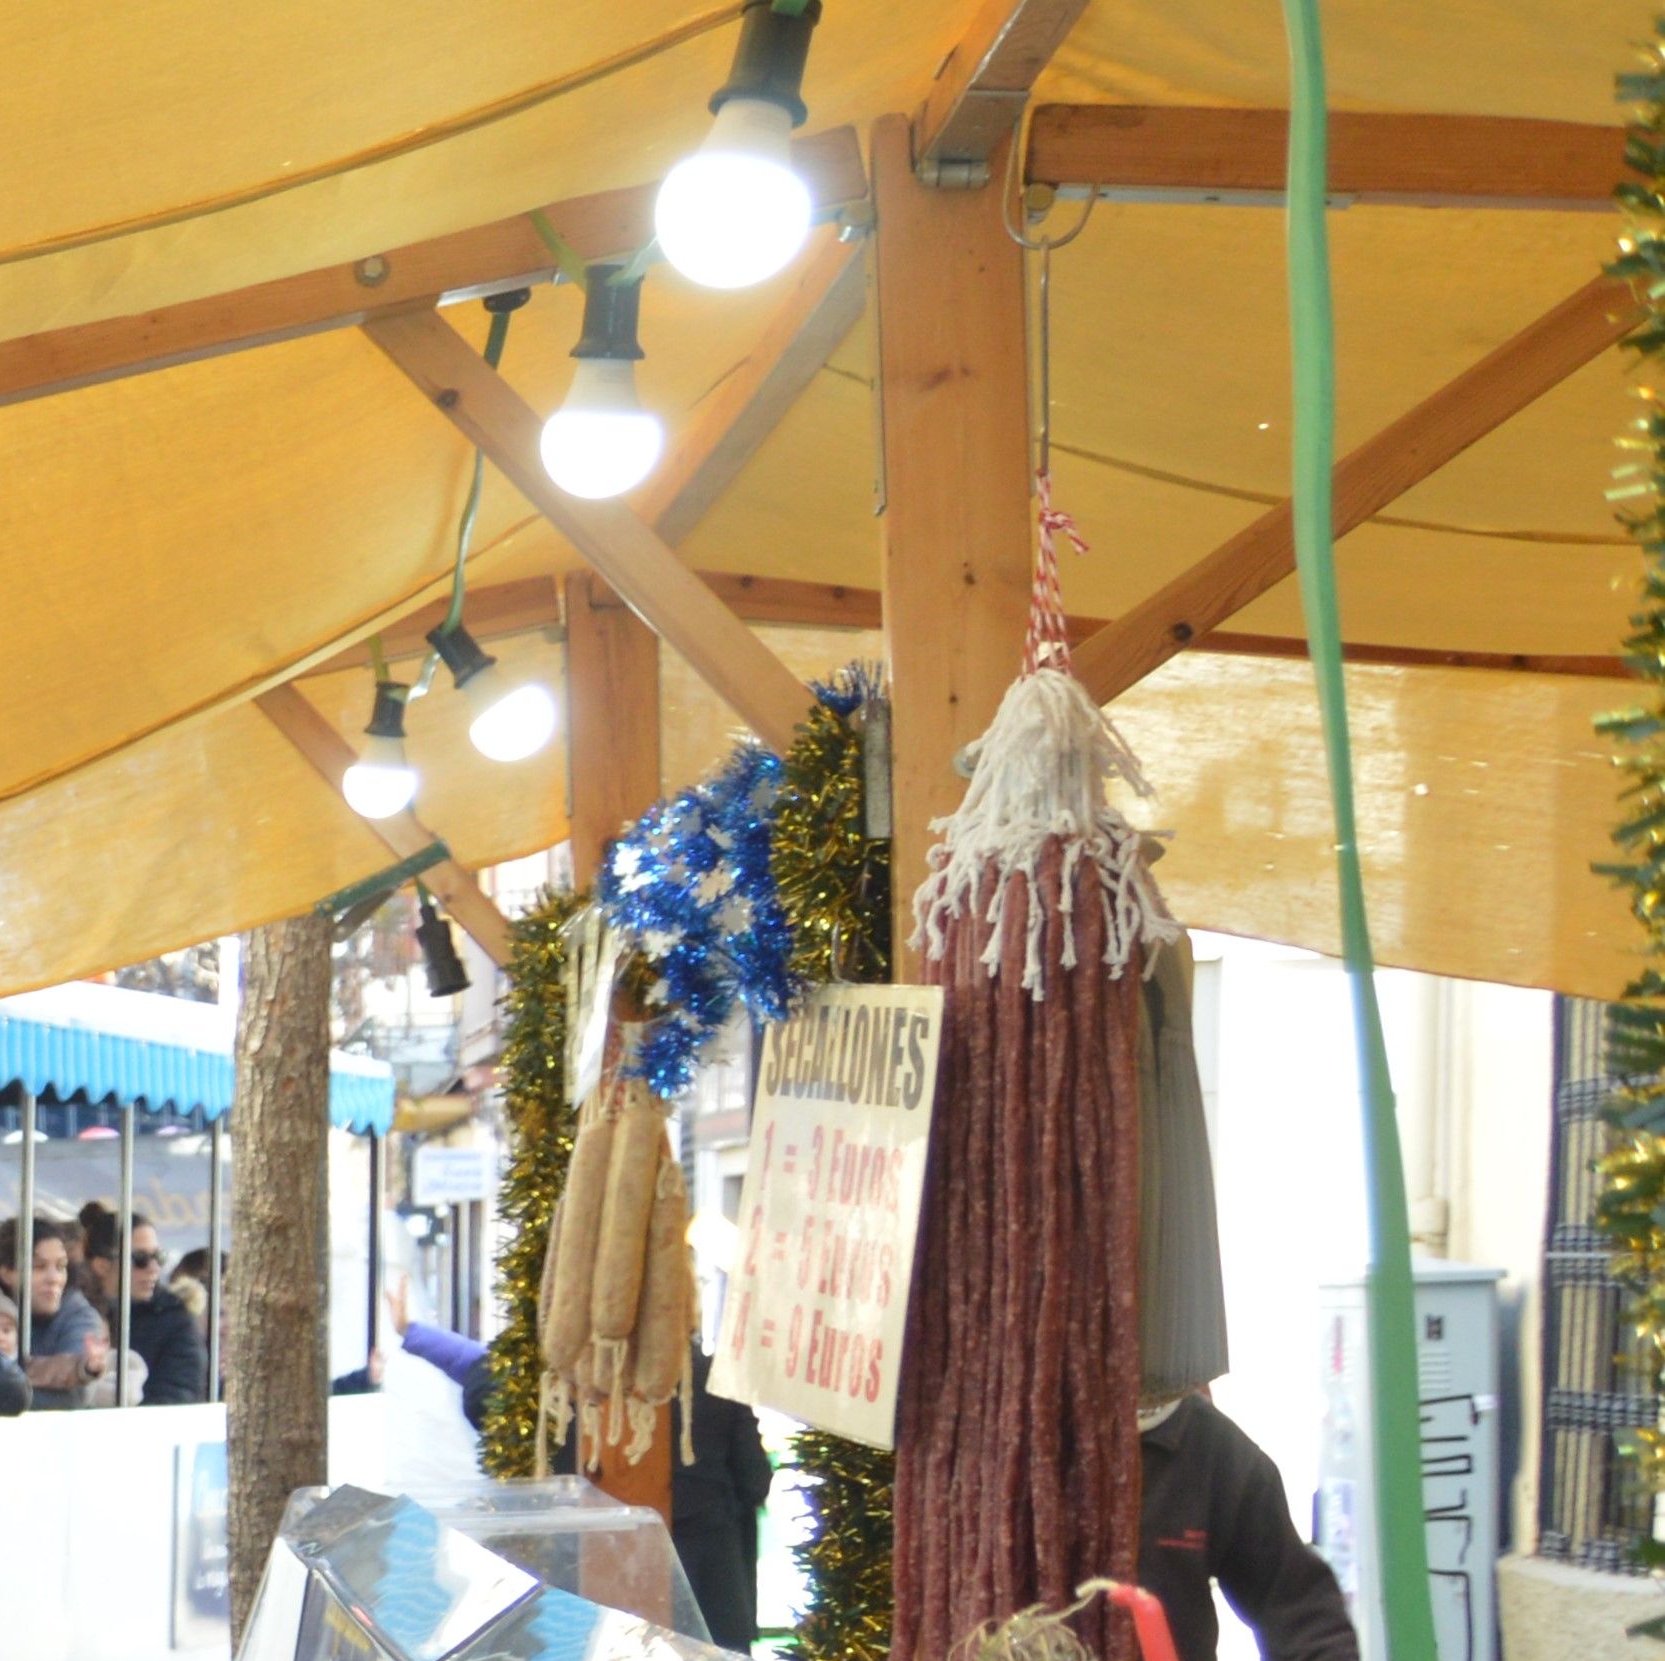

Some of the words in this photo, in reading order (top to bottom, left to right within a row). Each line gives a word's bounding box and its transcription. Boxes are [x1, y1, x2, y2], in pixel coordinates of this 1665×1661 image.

[765, 1003, 930, 1111] SECALLONES
[760, 1120, 775, 1192] 1
[807, 1123, 825, 1202] 3
[825, 1128, 904, 1214] Euros
[744, 1204, 764, 1277] 2
[797, 1214, 816, 1291] 5
[818, 1219, 895, 1309] Euros
[731, 1290, 752, 1361] 4
[784, 1304, 803, 1380] 9
[805, 1309, 884, 1404] Euros
